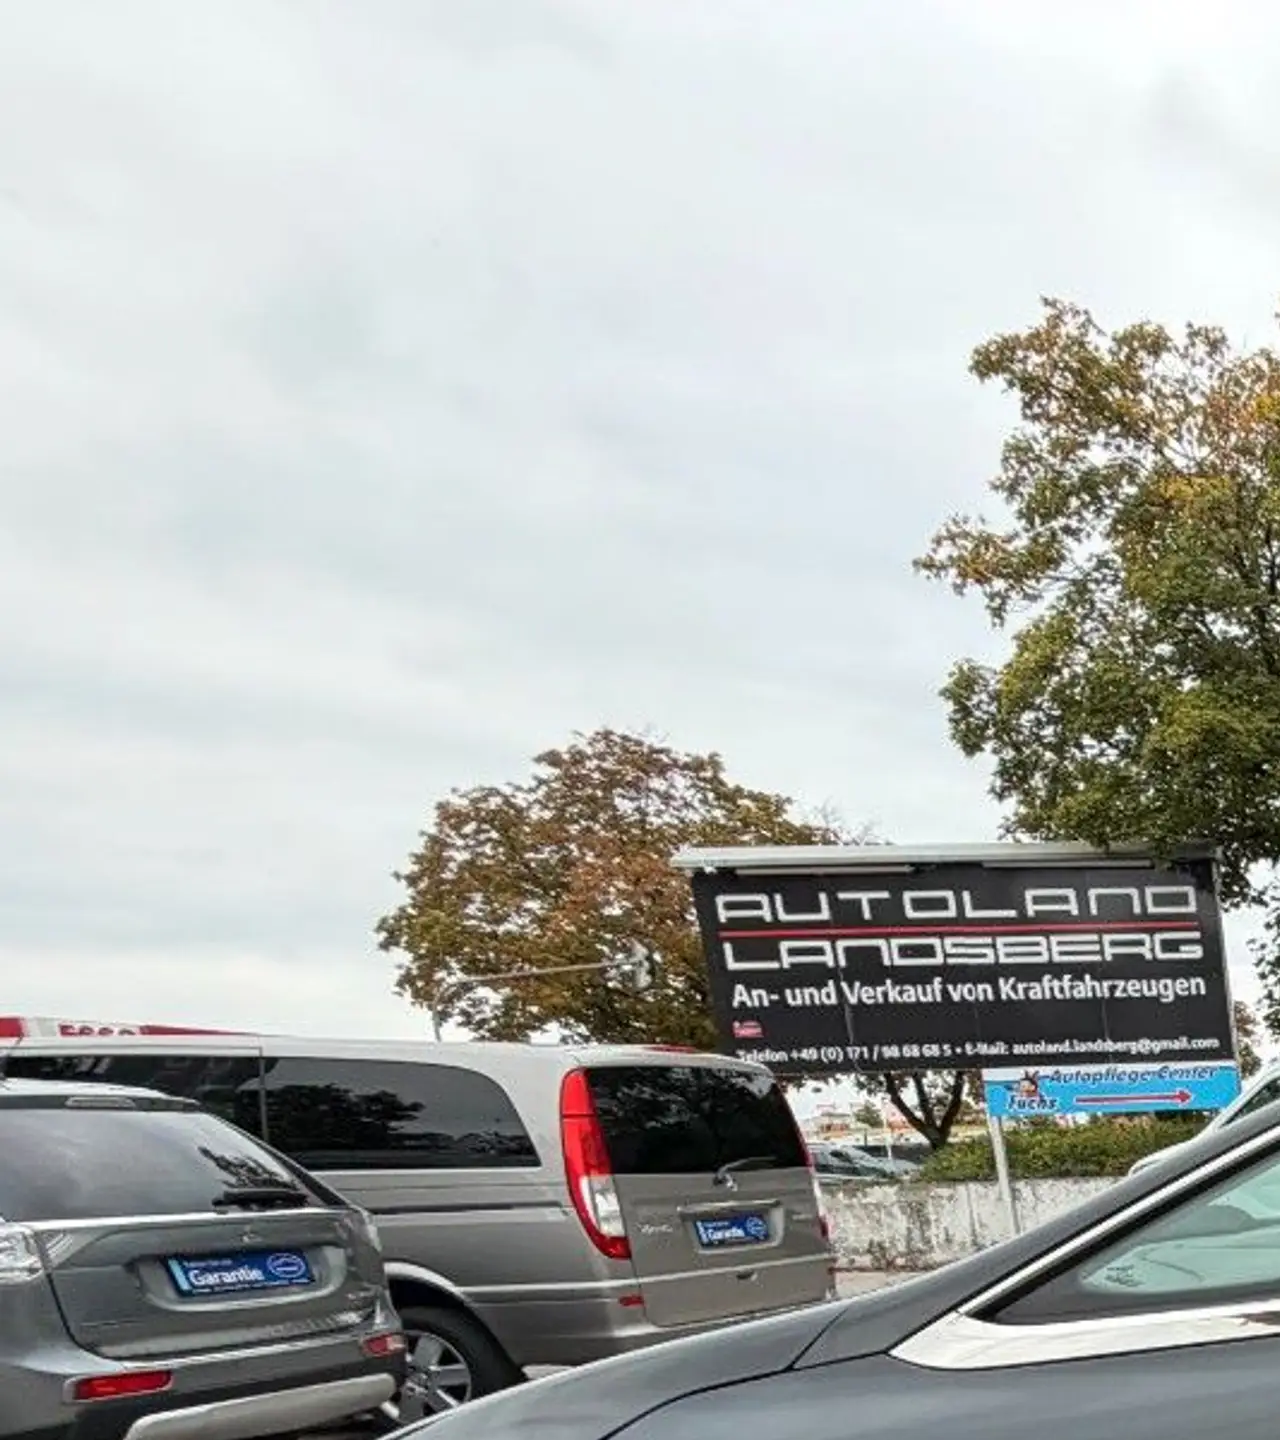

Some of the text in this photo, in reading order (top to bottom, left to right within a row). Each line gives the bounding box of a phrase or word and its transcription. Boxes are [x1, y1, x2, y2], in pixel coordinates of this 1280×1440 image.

[715, 885, 1198, 923] AUTOLAND
[722, 930, 1204, 971] LANDSBERG
[732, 973, 1206, 1008] An- und Verkauf von Kraftfahrzeugen
[820, 1046, 844, 1064] (0)
[1008, 1095, 1057, 1111] Fuchs
[188, 1264, 265, 1287] Garantie
